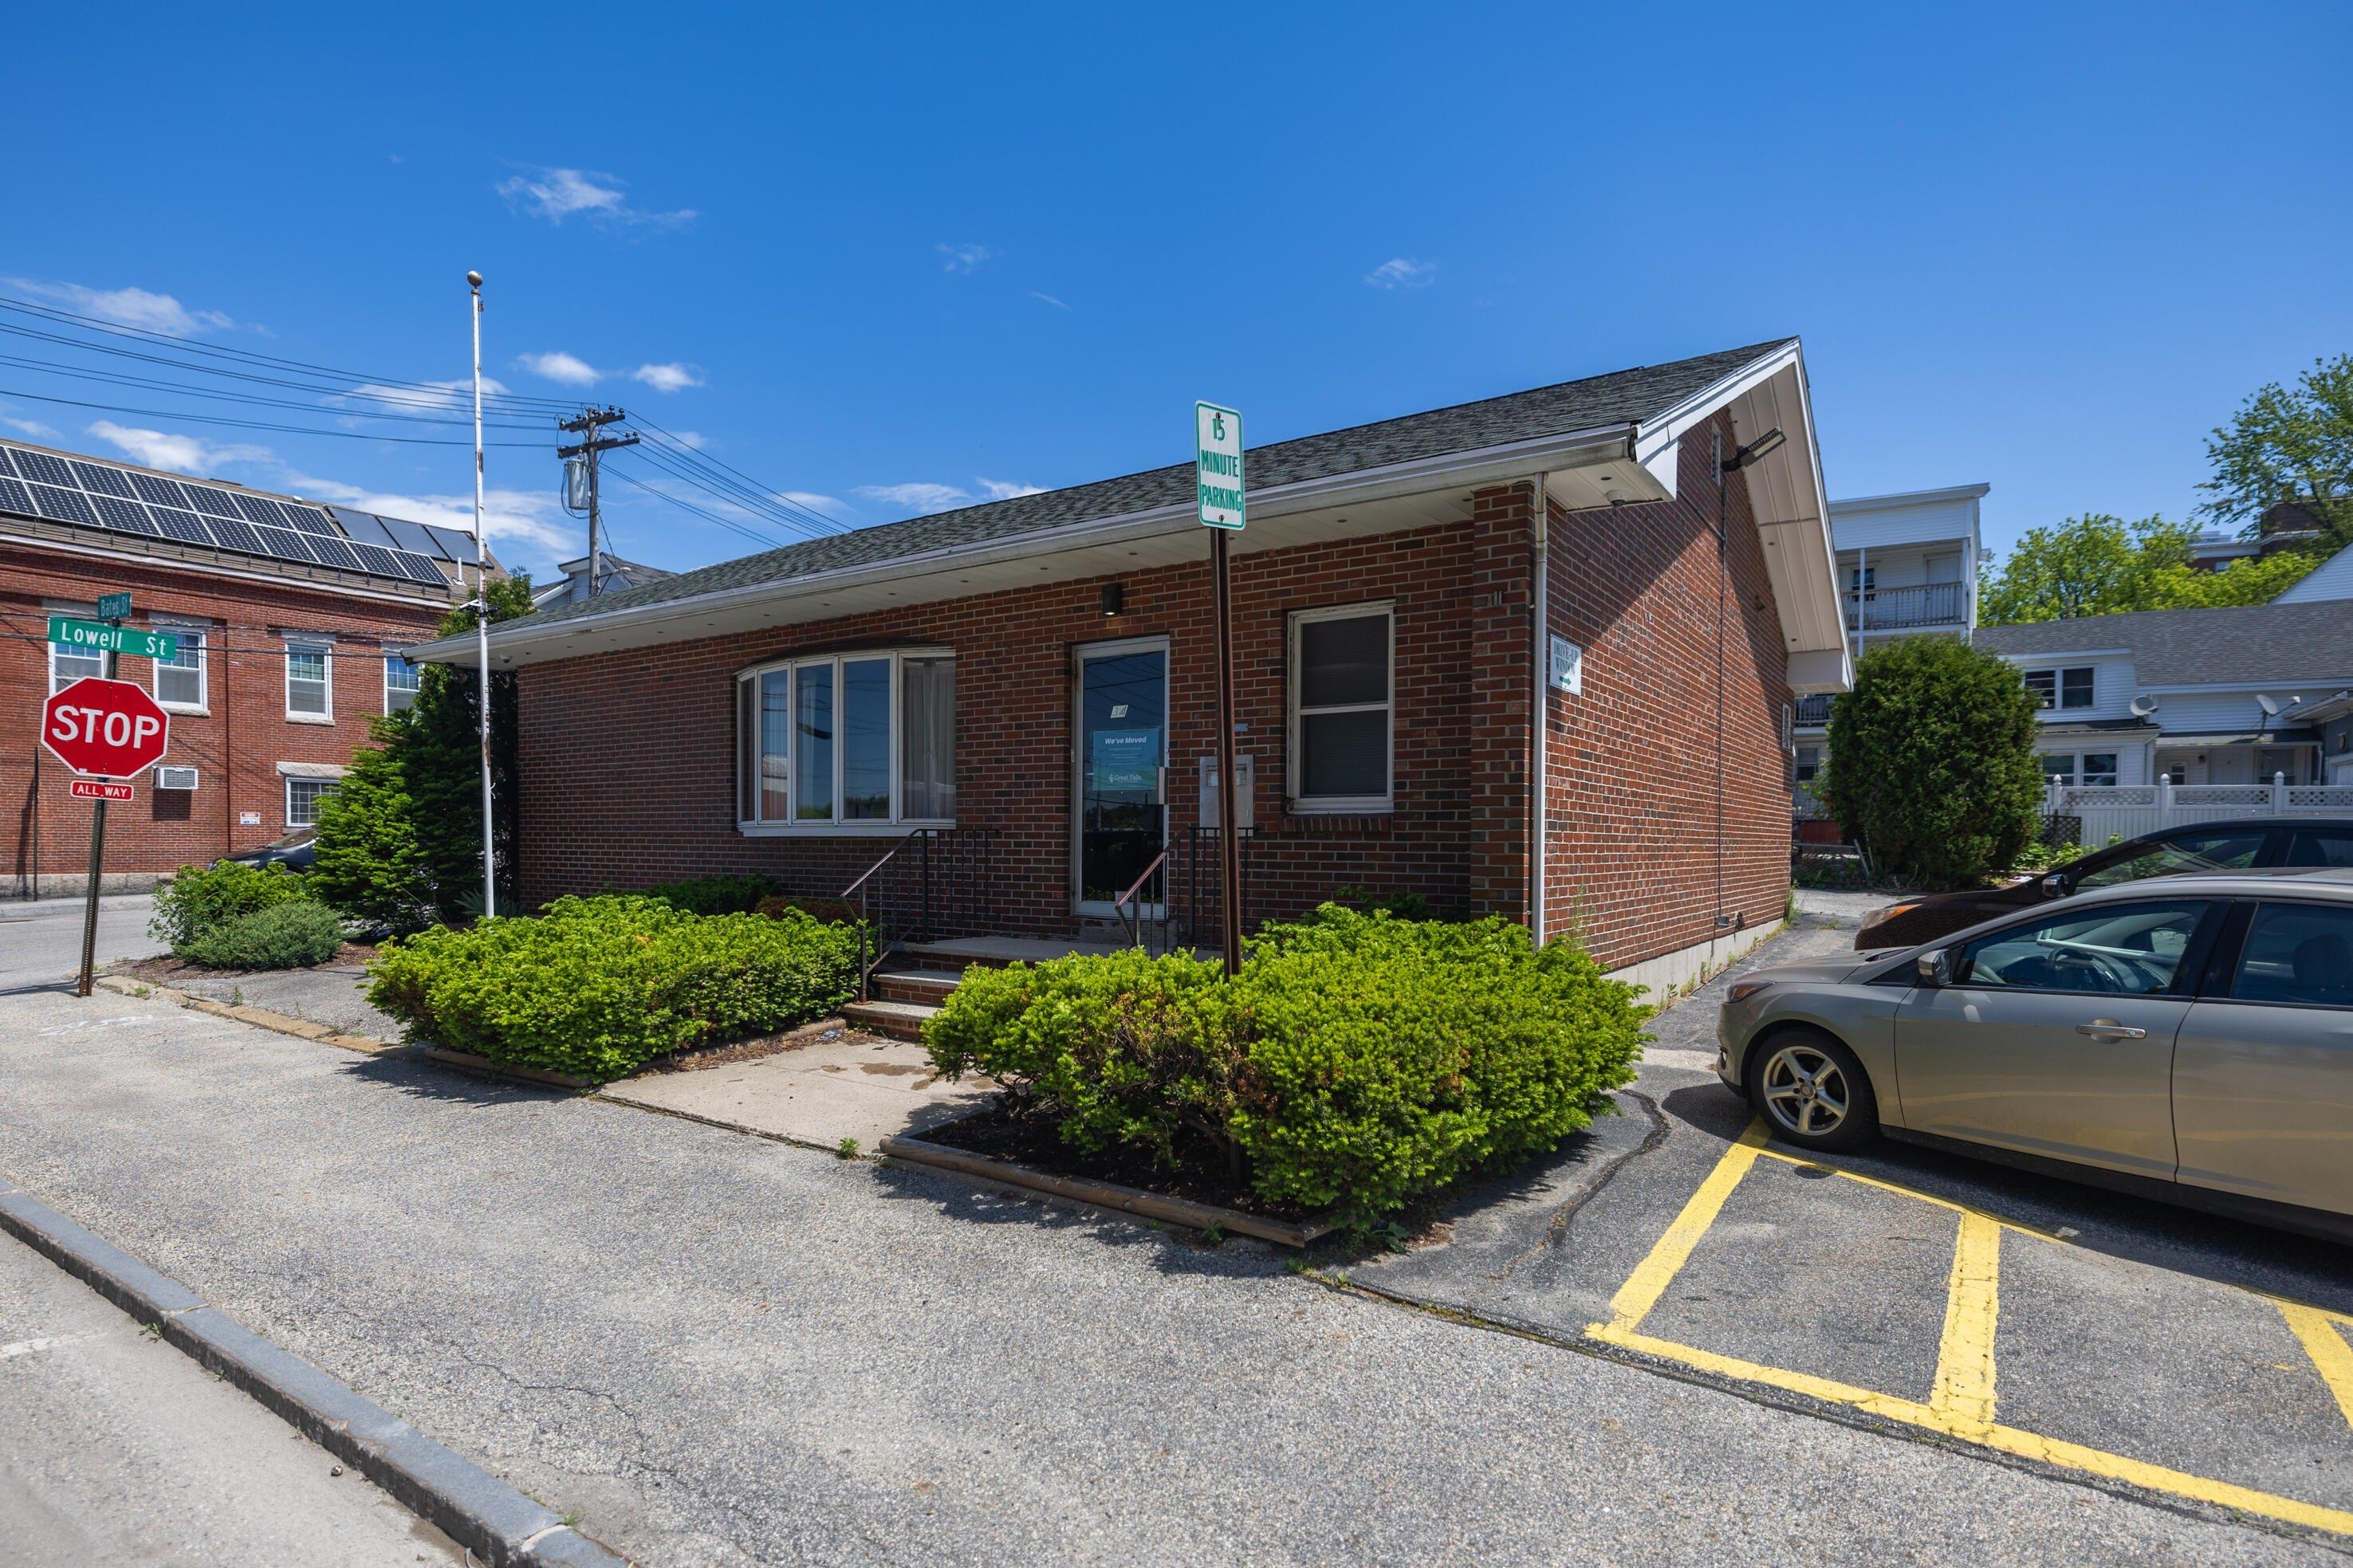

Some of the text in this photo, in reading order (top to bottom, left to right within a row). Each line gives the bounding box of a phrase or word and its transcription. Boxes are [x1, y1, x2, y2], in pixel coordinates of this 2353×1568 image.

[1212, 419, 1226, 441] 15
[1201, 449, 1239, 477] MINUTE
[1202, 484, 1242, 512] PARKING
[100, 595, 128, 617] Bates St
[61, 623, 167, 655] Lowell St
[51, 705, 160, 749] STOP
[77, 784, 128, 797] ALL WAY
